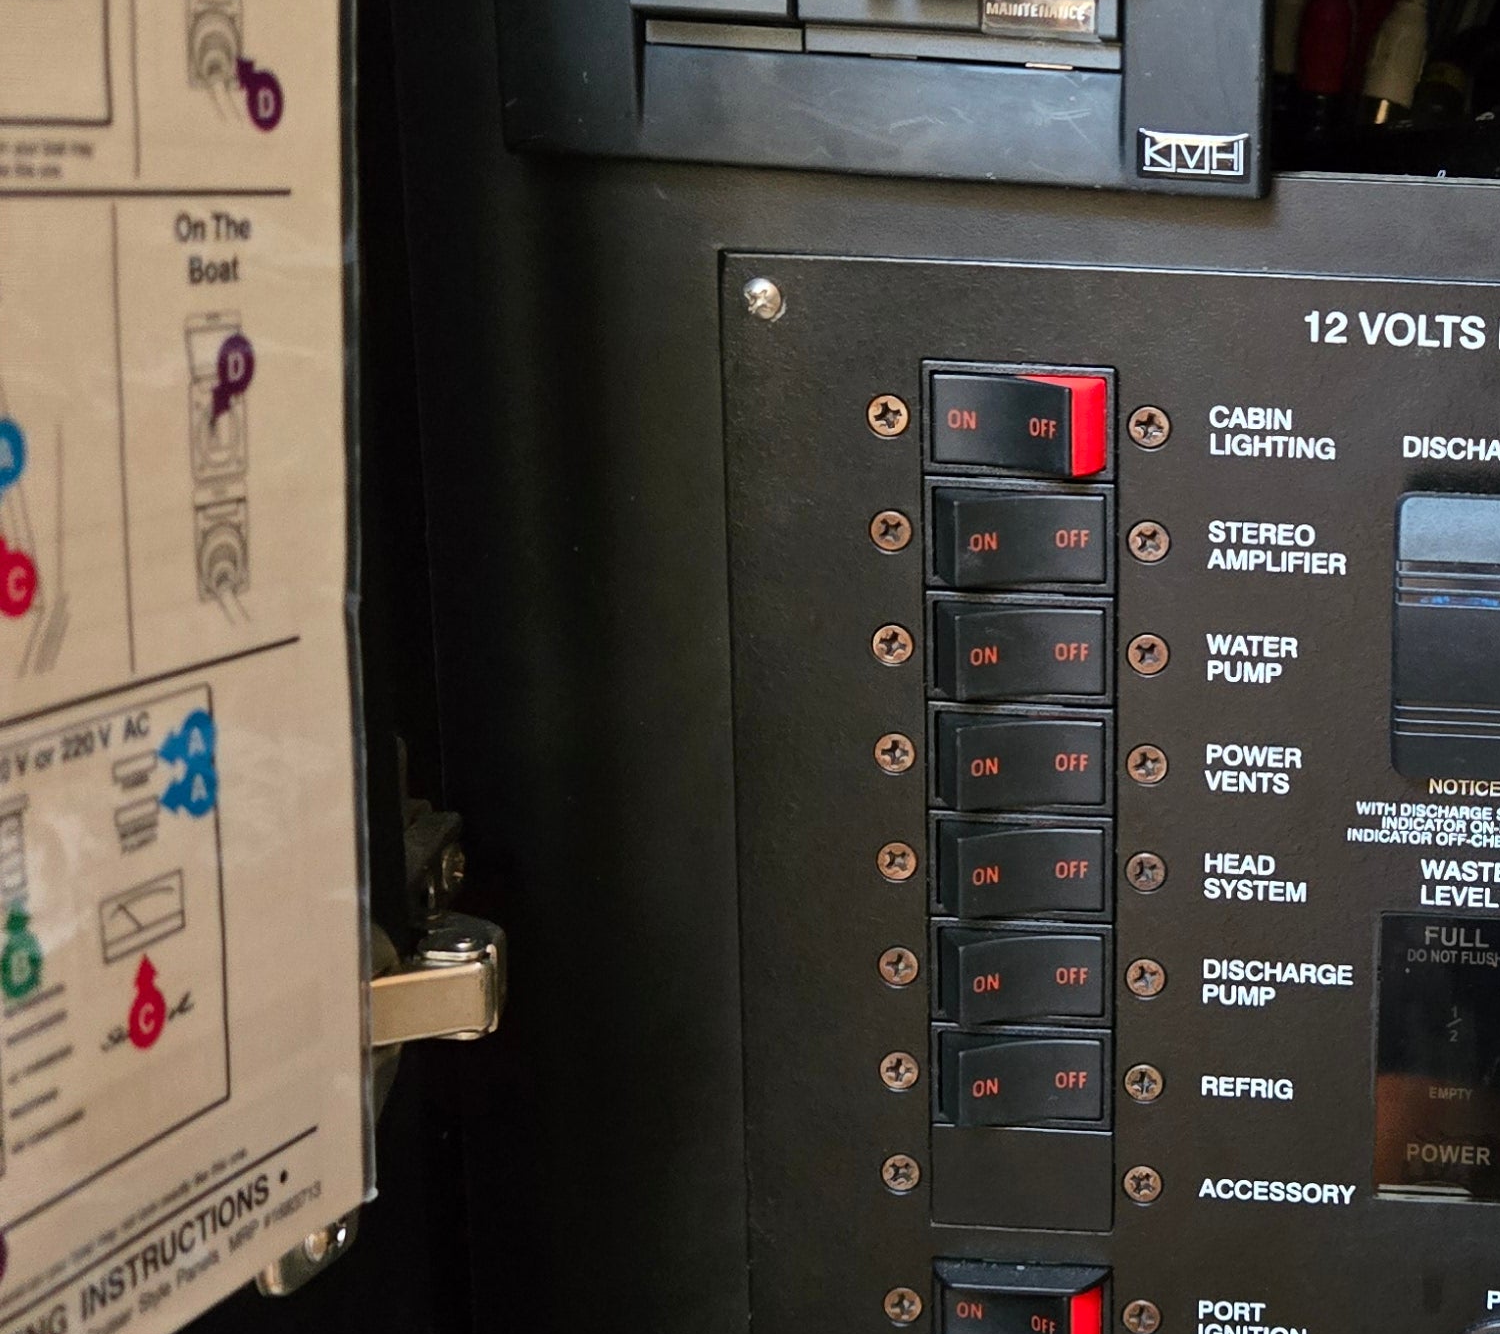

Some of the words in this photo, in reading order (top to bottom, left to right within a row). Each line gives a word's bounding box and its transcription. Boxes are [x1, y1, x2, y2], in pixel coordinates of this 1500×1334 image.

[986, 2, 1085, 20] MAINTENANCE
[1141, 131, 1248, 175] KVH
[175, 213, 205, 242] On
[214, 212, 251, 241] The
[189, 256, 239, 285] Boat
[1304, 311, 1347, 344] 12
[1359, 312, 1486, 350] VOLTS
[947, 409, 977, 430] ON
[1029, 417, 1057, 440] OFF
[1208, 406, 1292, 431] CABIN
[1210, 434, 1336, 460] LIGHTING
[1208, 521, 1316, 547] STEREO
[1208, 549, 1347, 576] AMPLIFIER
[1206, 633, 1298, 659] WATER
[1207, 661, 1282, 684] PUMP
[124, 711, 149, 742] AC
[1206, 744, 1302, 768] POWER
[1205, 771, 1290, 794] VENTS
[1356, 801, 1397, 816] WITH
[1401, 804, 1492, 820] DISCHARGE
[1382, 816, 1467, 833] INDICATOR
[1347, 828, 1432, 845] INDICATOR
[1205, 853, 1275, 877] HEAD
[1203, 878, 1307, 903] SYSTEM
[1421, 885, 1499, 908] LEVEL
[1425, 926, 1489, 948] FULL
[1408, 949, 1428, 962] DO
[1430, 950, 1458, 964] NOT
[1203, 959, 1354, 987] DISCHARGE
[1202, 984, 1276, 1007] PUMP
[1202, 1077, 1293, 1100] REFRIG
[1429, 1087, 1473, 1101] EMPTY
[1406, 1143, 1491, 1166] POWER
[1199, 1178, 1356, 1205] ACCESSORY
[80, 1173, 271, 1321] INSTRUCTIONS
[956, 1302, 982, 1320] ON
[1199, 1301, 1266, 1323] PORT
